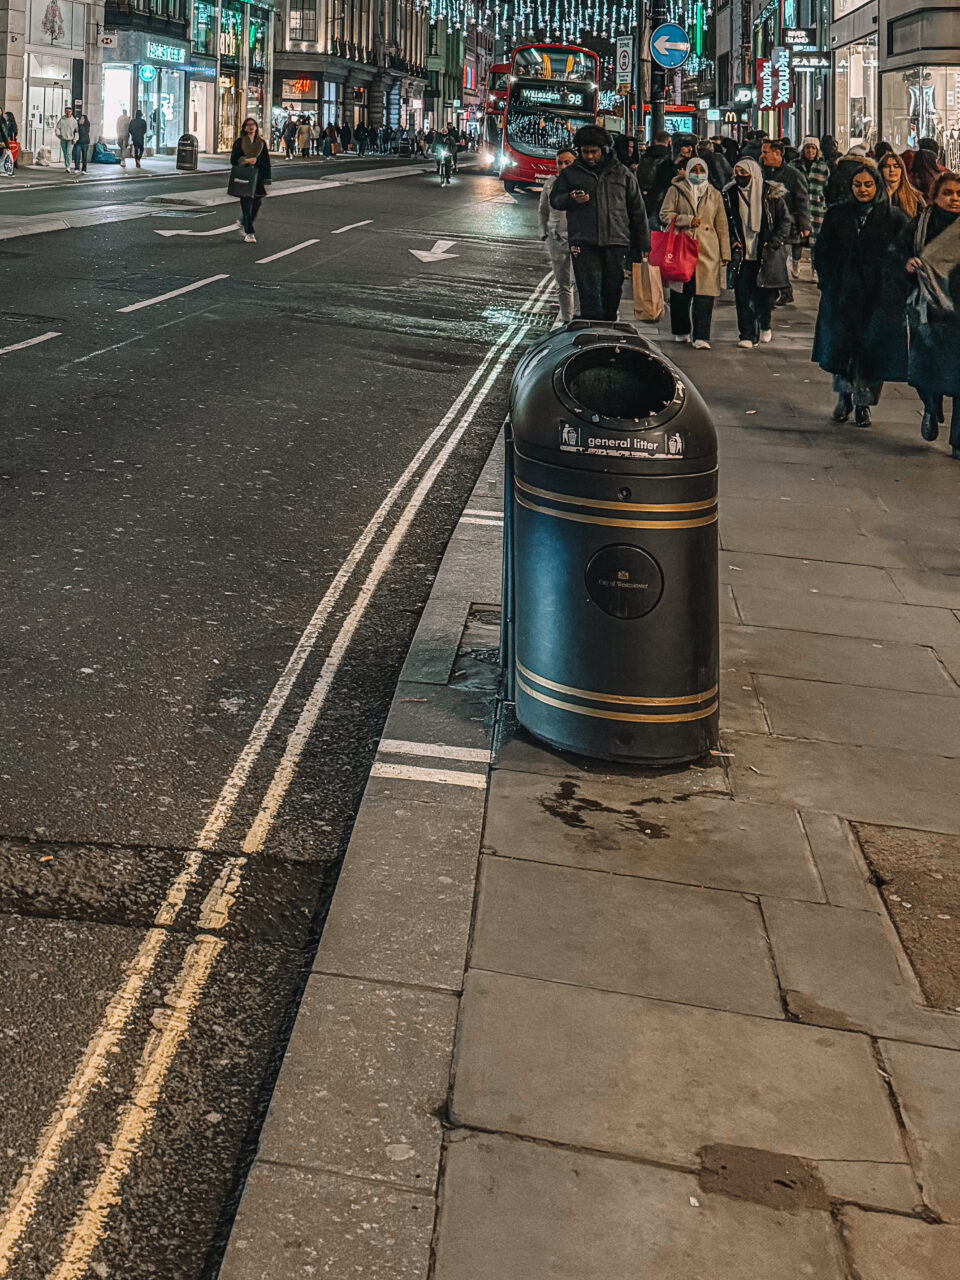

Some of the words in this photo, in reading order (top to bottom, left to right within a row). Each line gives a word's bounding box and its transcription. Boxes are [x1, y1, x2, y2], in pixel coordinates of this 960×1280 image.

[785, 36, 809, 44] ISLAND
[791, 57, 830, 66] ZARA
[522, 88, 561, 100] Willesden
[567, 93, 582, 105] 98
[734, 89, 752, 102] JD
[587, 437, 631, 448] general
[633, 438, 659, 450] litter
